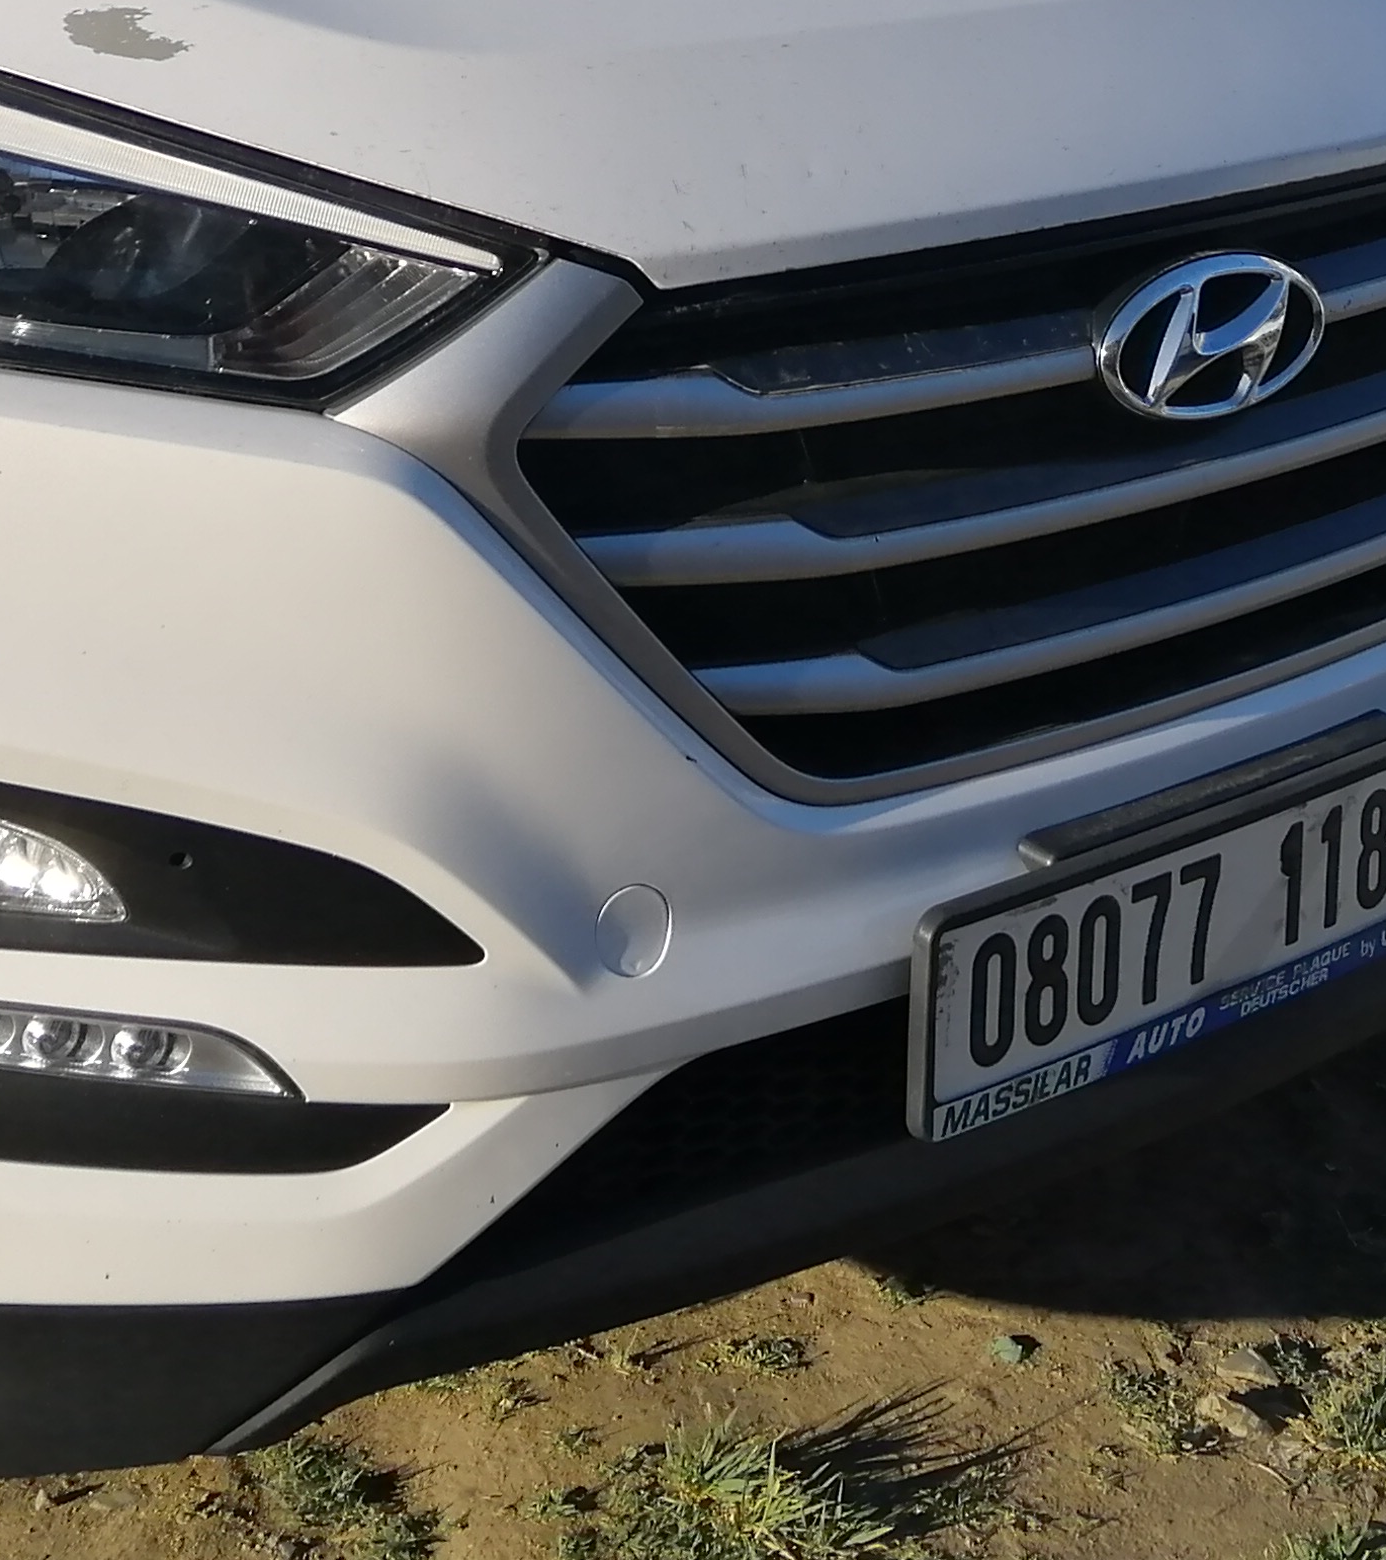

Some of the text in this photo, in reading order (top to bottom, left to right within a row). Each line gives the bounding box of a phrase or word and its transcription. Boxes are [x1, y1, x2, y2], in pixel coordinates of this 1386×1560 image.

[968, 854, 1222, 1068] 08077
[1219, 970, 1286, 1011] SERVICE
[1292, 941, 1351, 983] PLAQUE
[1360, 939, 1376, 959] by
[1239, 967, 1329, 1018] DEUTSCHER
[1126, 1006, 1206, 1064] AUTO
